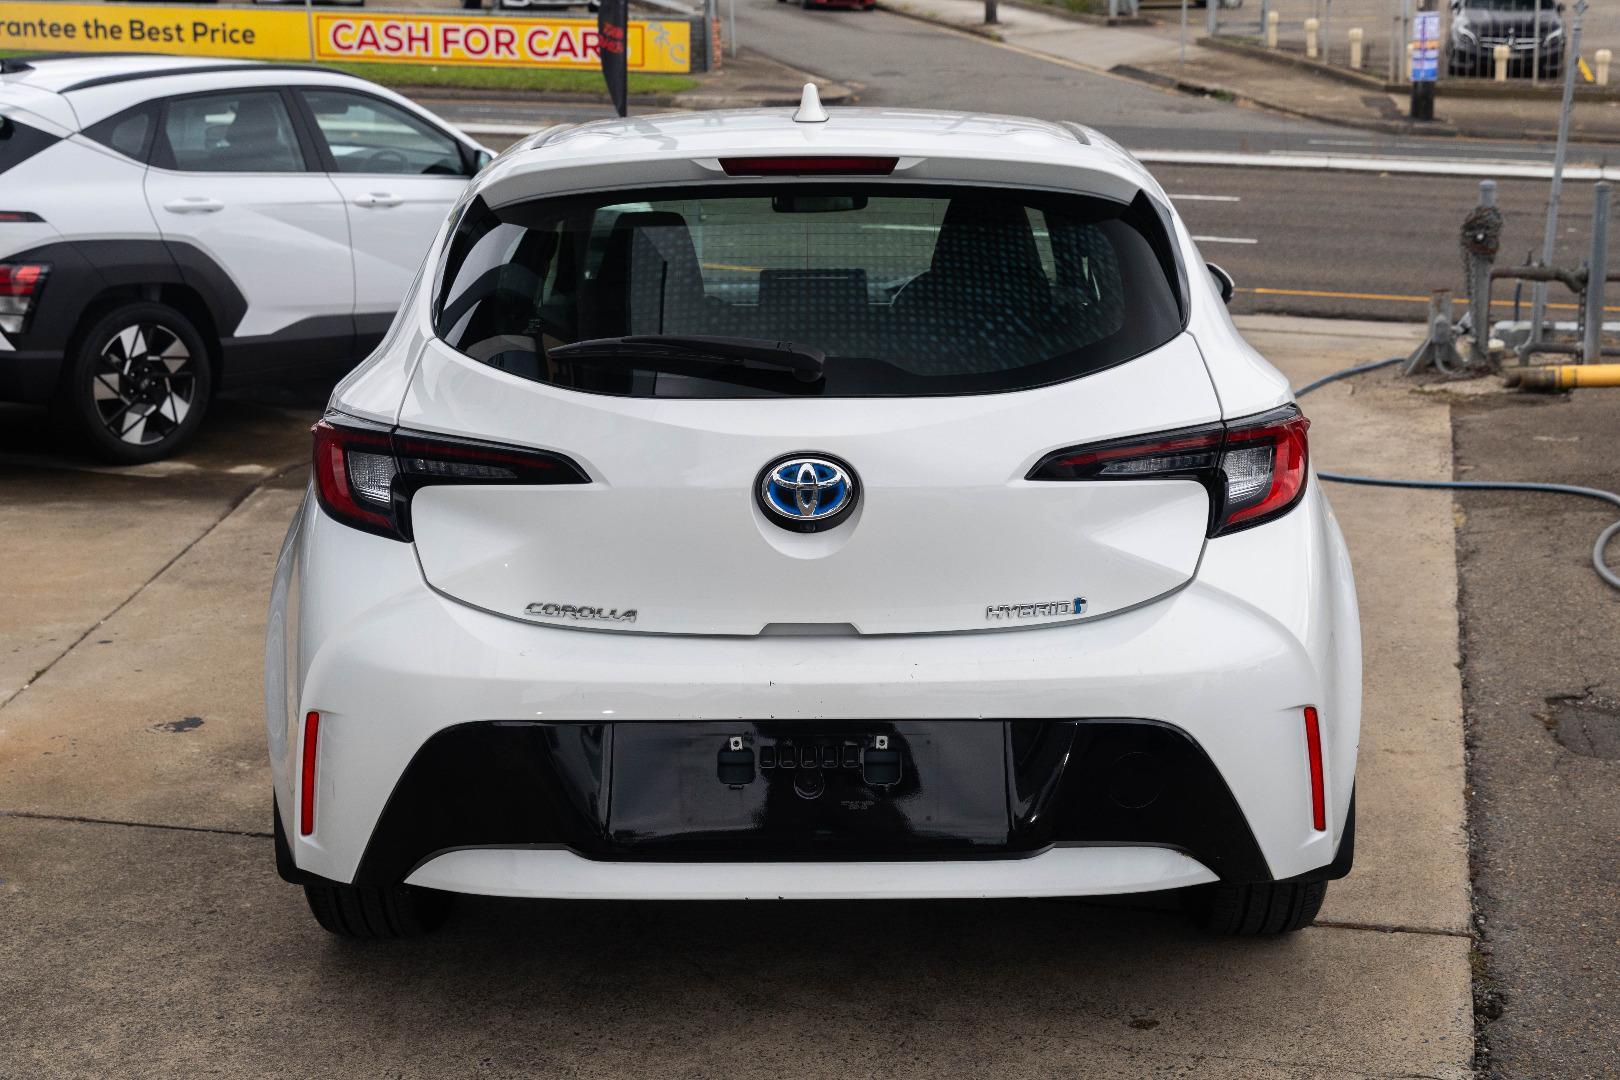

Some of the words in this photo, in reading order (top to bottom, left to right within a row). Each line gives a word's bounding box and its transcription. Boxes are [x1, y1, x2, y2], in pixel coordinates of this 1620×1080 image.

[83, 19, 123, 40] the
[129, 20, 185, 42] Best
[192, 22, 256, 44] Price
[332, 23, 430, 53] CASH
[443, 27, 517, 57] FOR
[527, 30, 602, 59] CAR
[524, 602, 638, 623] COROLLA
[985, 600, 1071, 620] HYBRID
